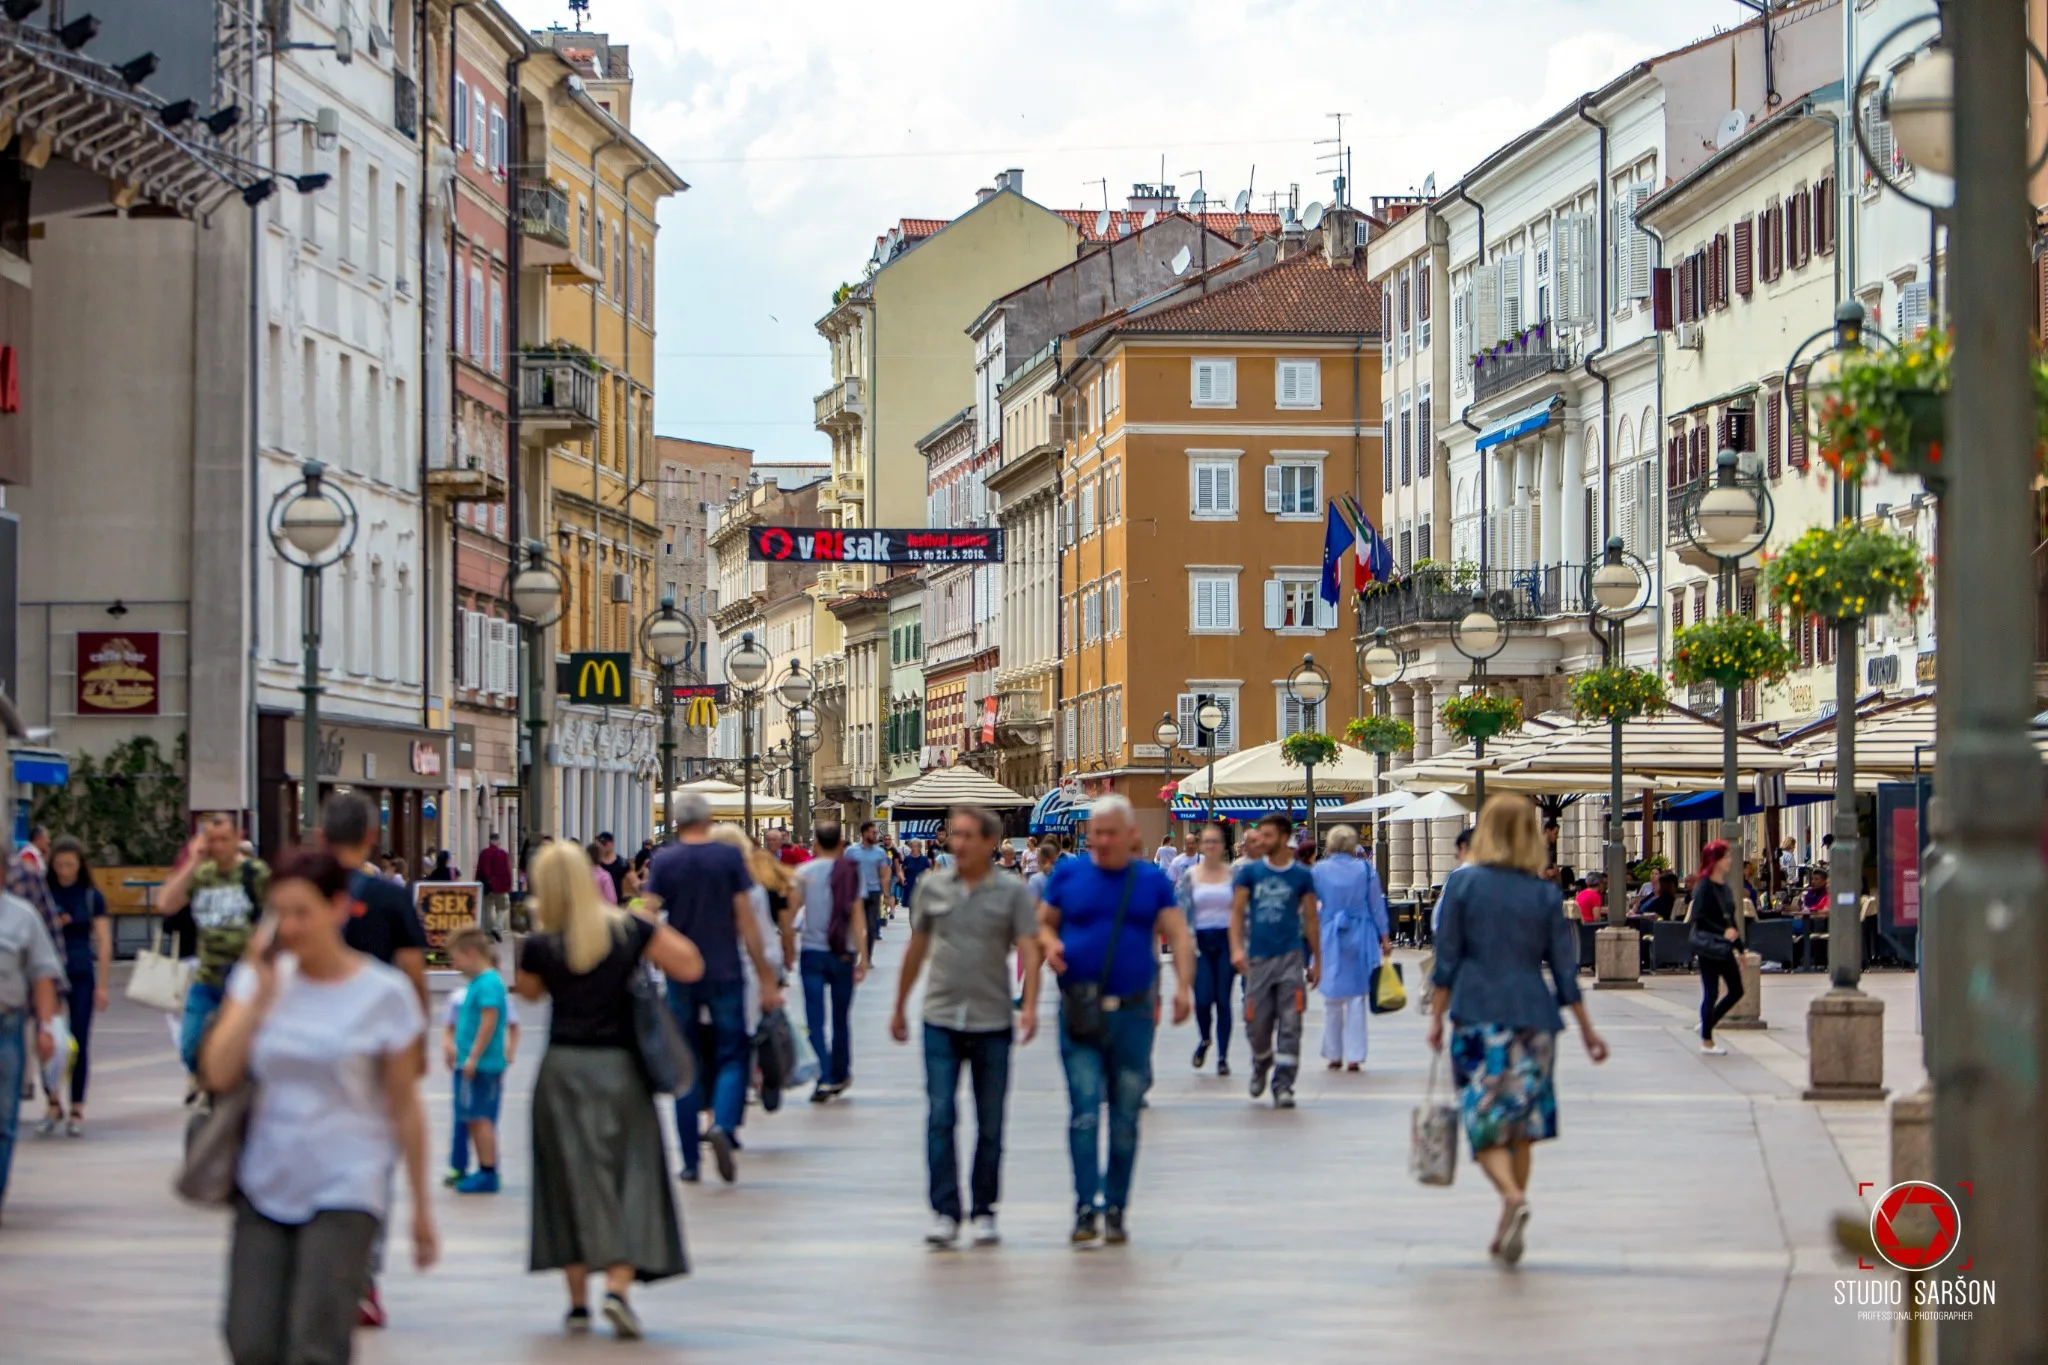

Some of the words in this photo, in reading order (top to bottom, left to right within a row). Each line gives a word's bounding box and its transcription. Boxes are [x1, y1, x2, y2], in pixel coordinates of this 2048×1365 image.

[798, 531, 891, 561] vRIsak
[908, 549, 922, 560] 13.
[936, 549, 950, 560] 21.
[952, 549, 961, 560] 5.
[963, 549, 987, 560] 2018.
[429, 895, 469, 914] SEX
